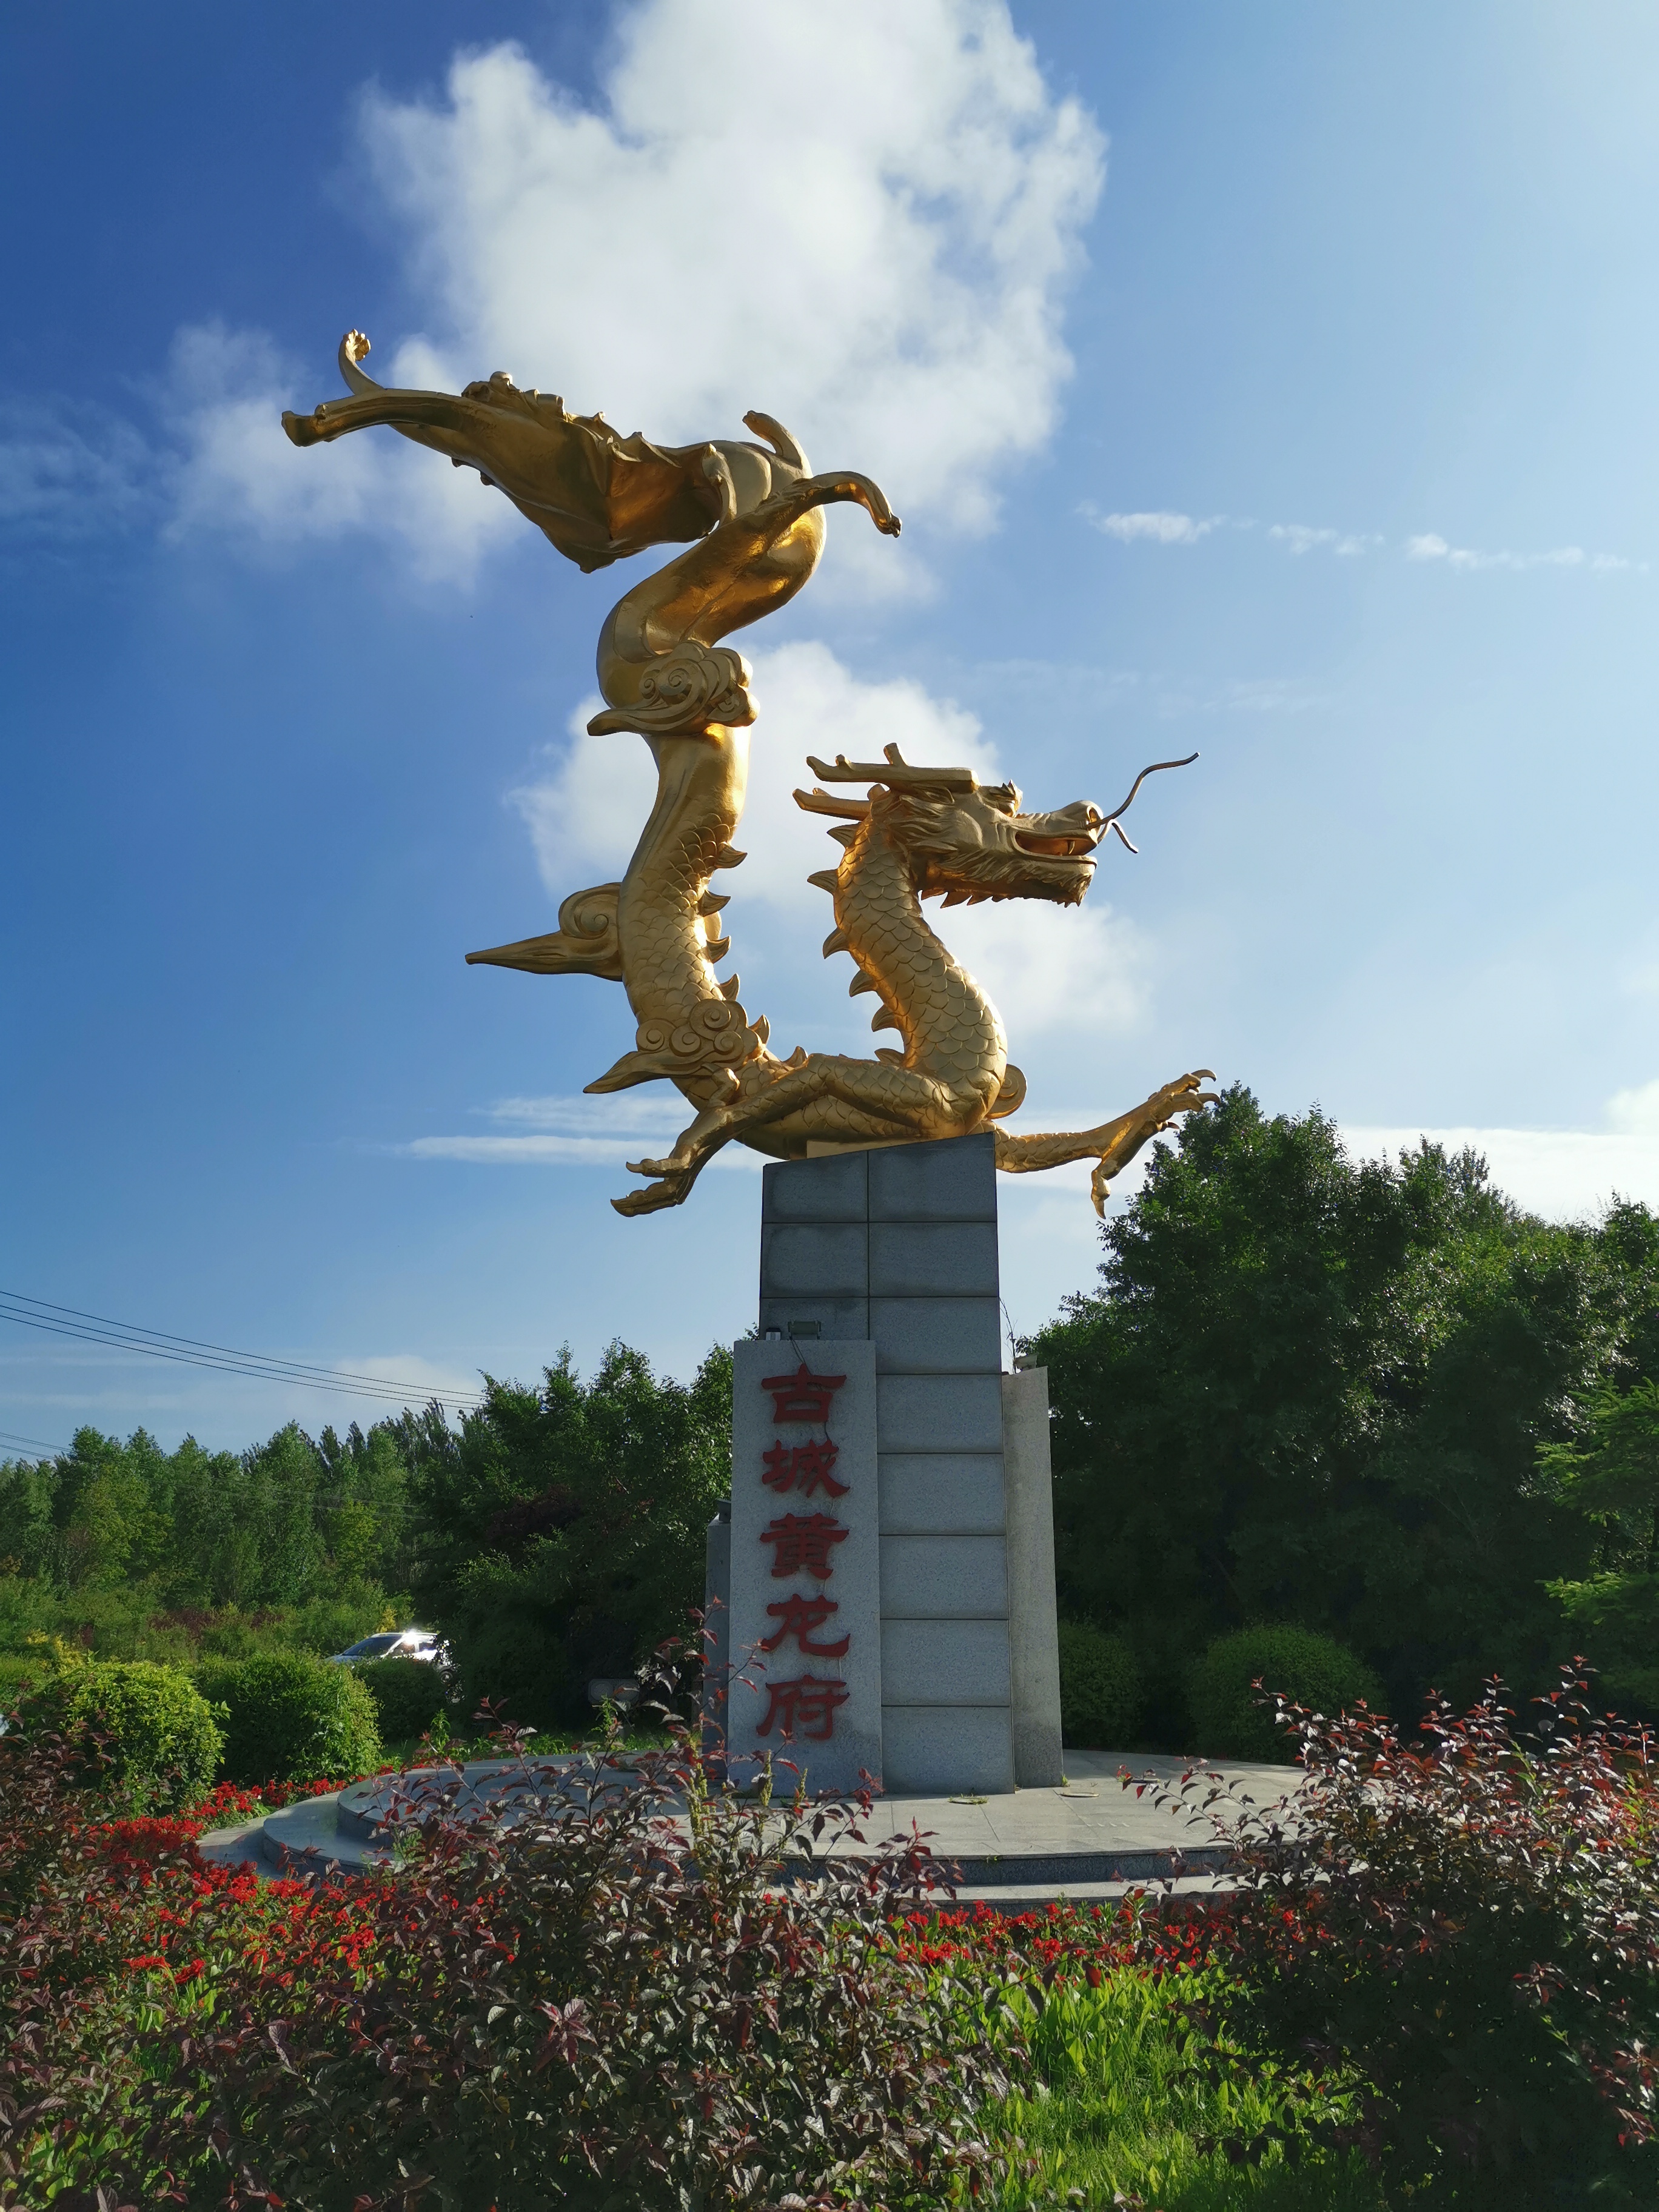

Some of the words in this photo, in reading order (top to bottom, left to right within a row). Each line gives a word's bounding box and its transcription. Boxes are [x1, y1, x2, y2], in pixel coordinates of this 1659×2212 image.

[756, 1364, 851, 1740] 古城黄龙府
